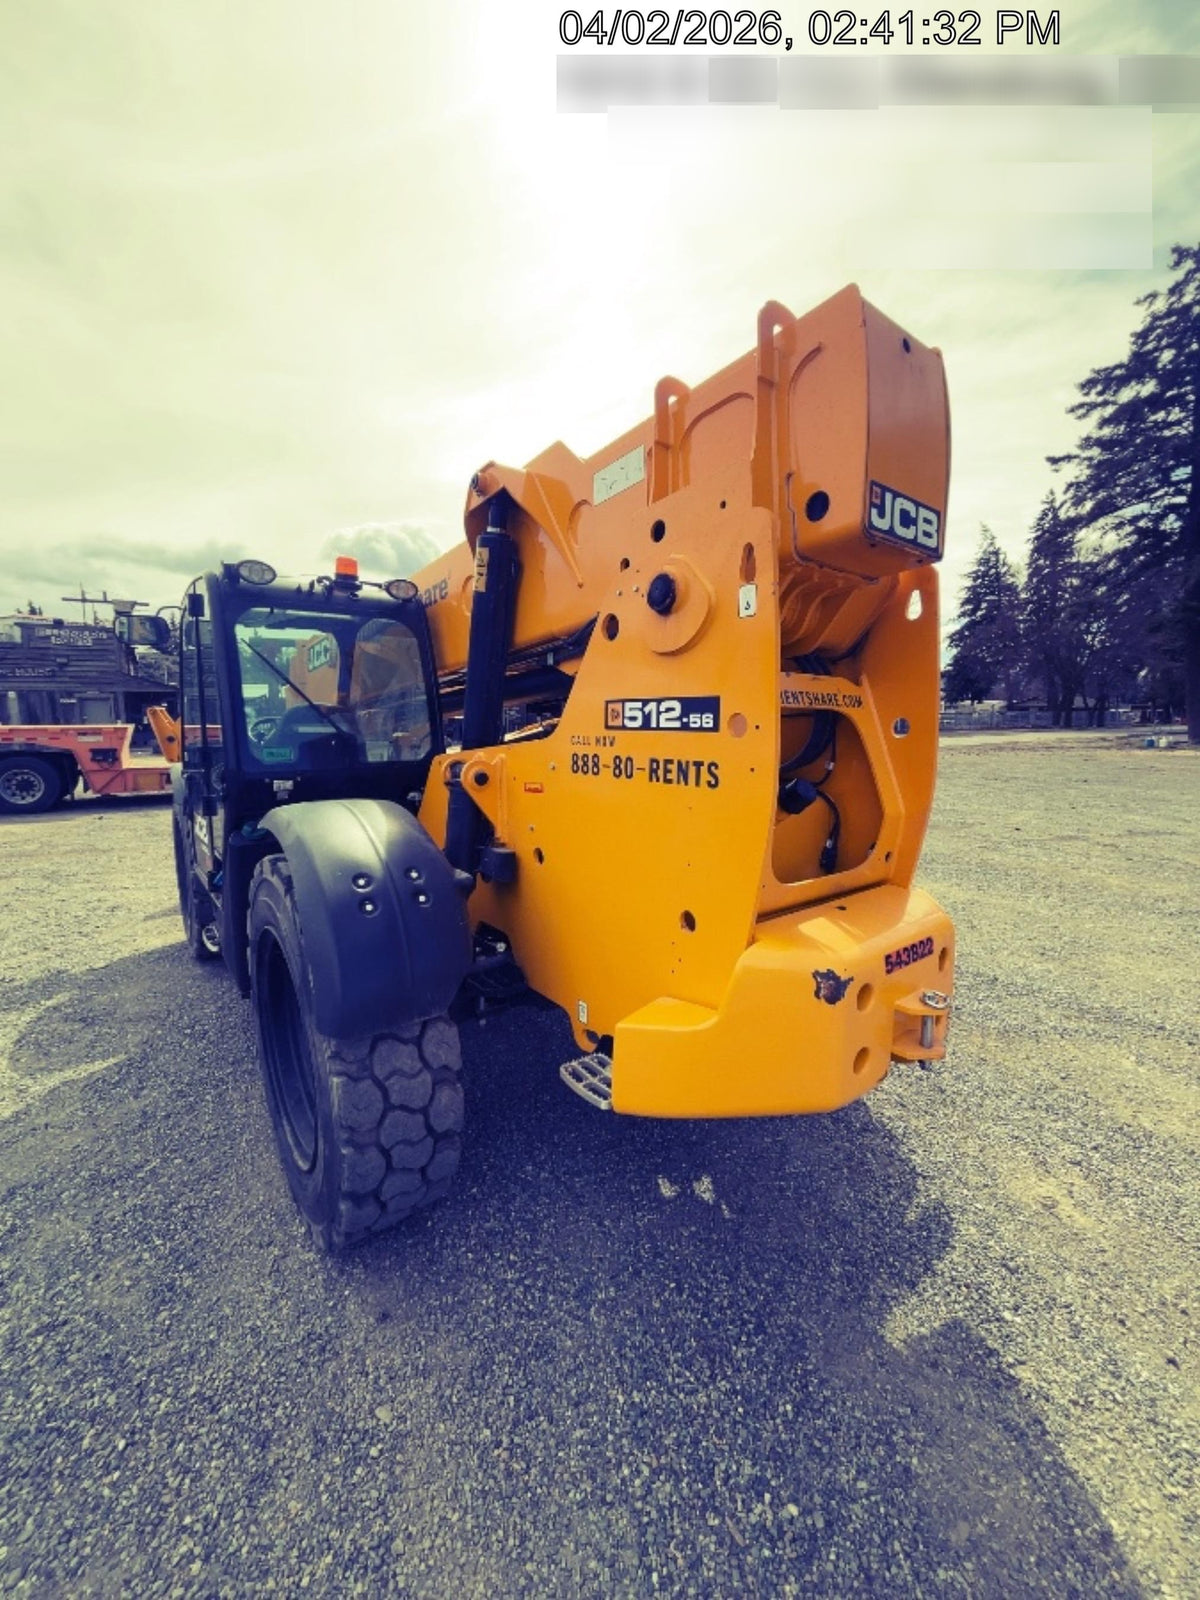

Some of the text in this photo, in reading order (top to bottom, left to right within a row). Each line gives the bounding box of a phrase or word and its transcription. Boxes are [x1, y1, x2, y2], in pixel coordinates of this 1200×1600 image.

[871, 491, 938, 549] JCB
[623, 699, 714, 728] 512-56
[570, 735, 616, 747] CALL NOW
[571, 752, 720, 790] 888-80-RENTS
